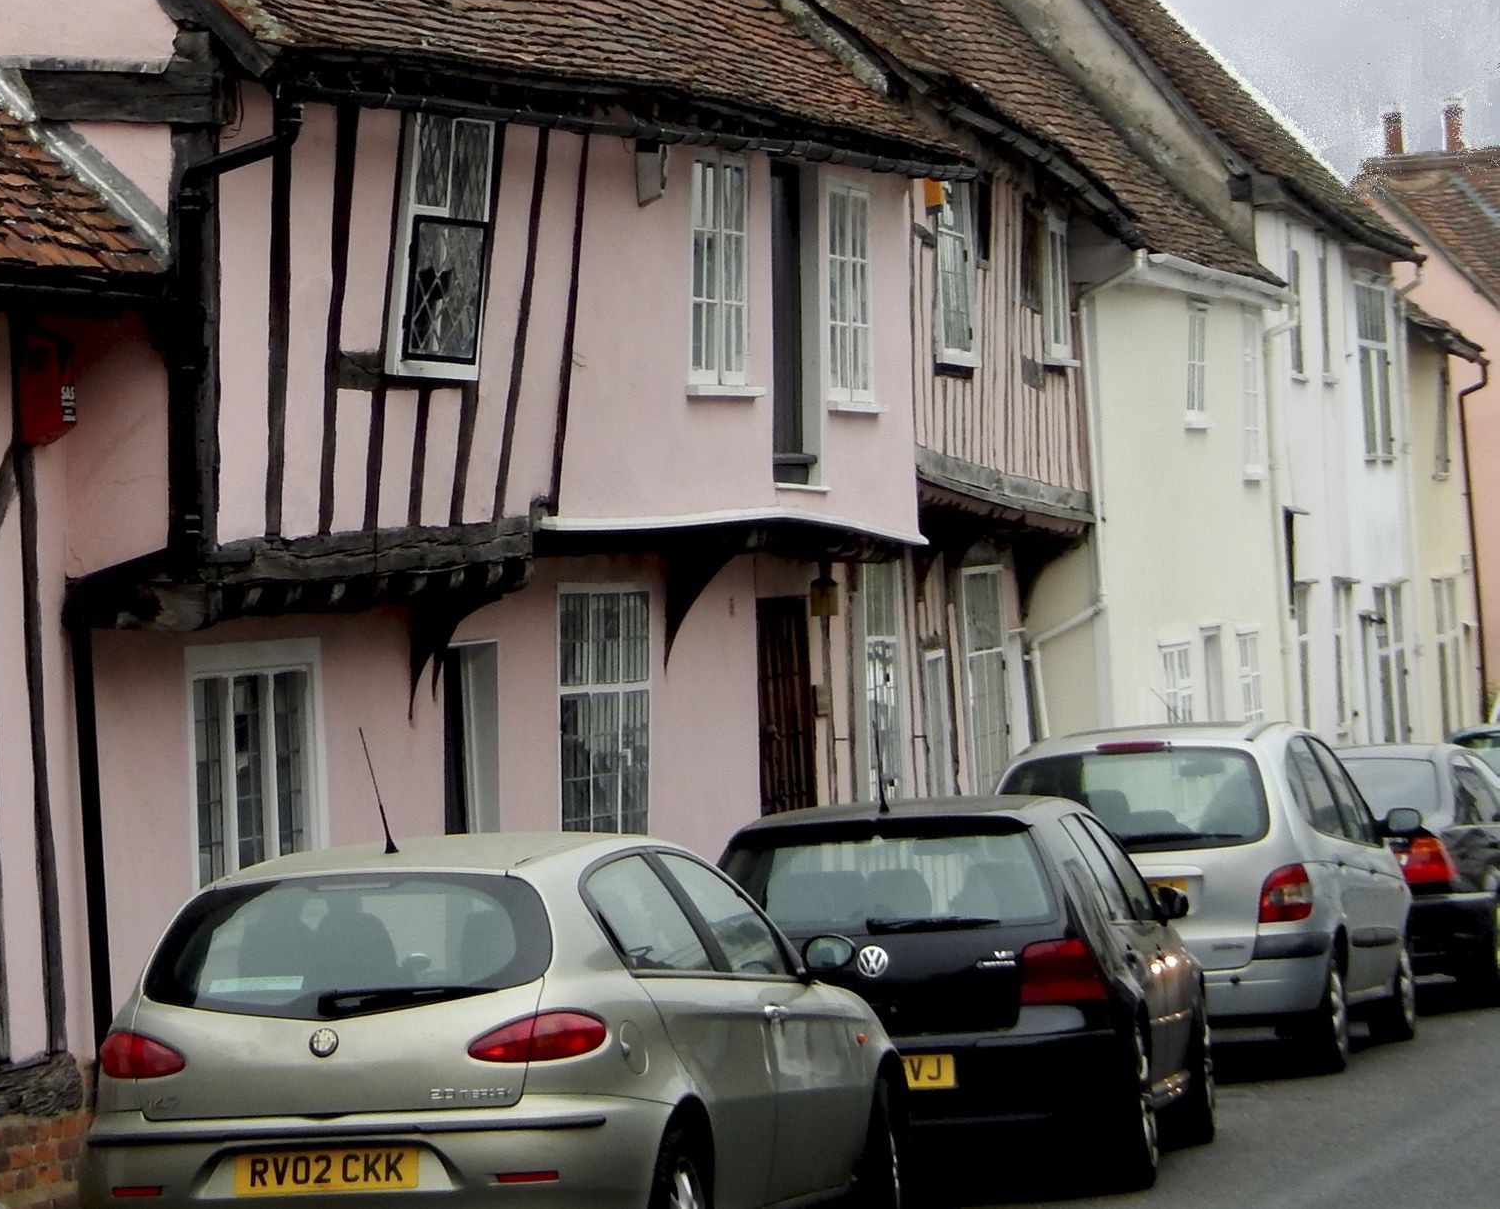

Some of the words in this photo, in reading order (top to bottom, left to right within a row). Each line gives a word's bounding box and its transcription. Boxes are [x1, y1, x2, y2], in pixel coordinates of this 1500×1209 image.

[901, 1057, 942, 1081] VJ
[250, 1155, 332, 1187] RV02
[342, 1152, 405, 1183] CKK
